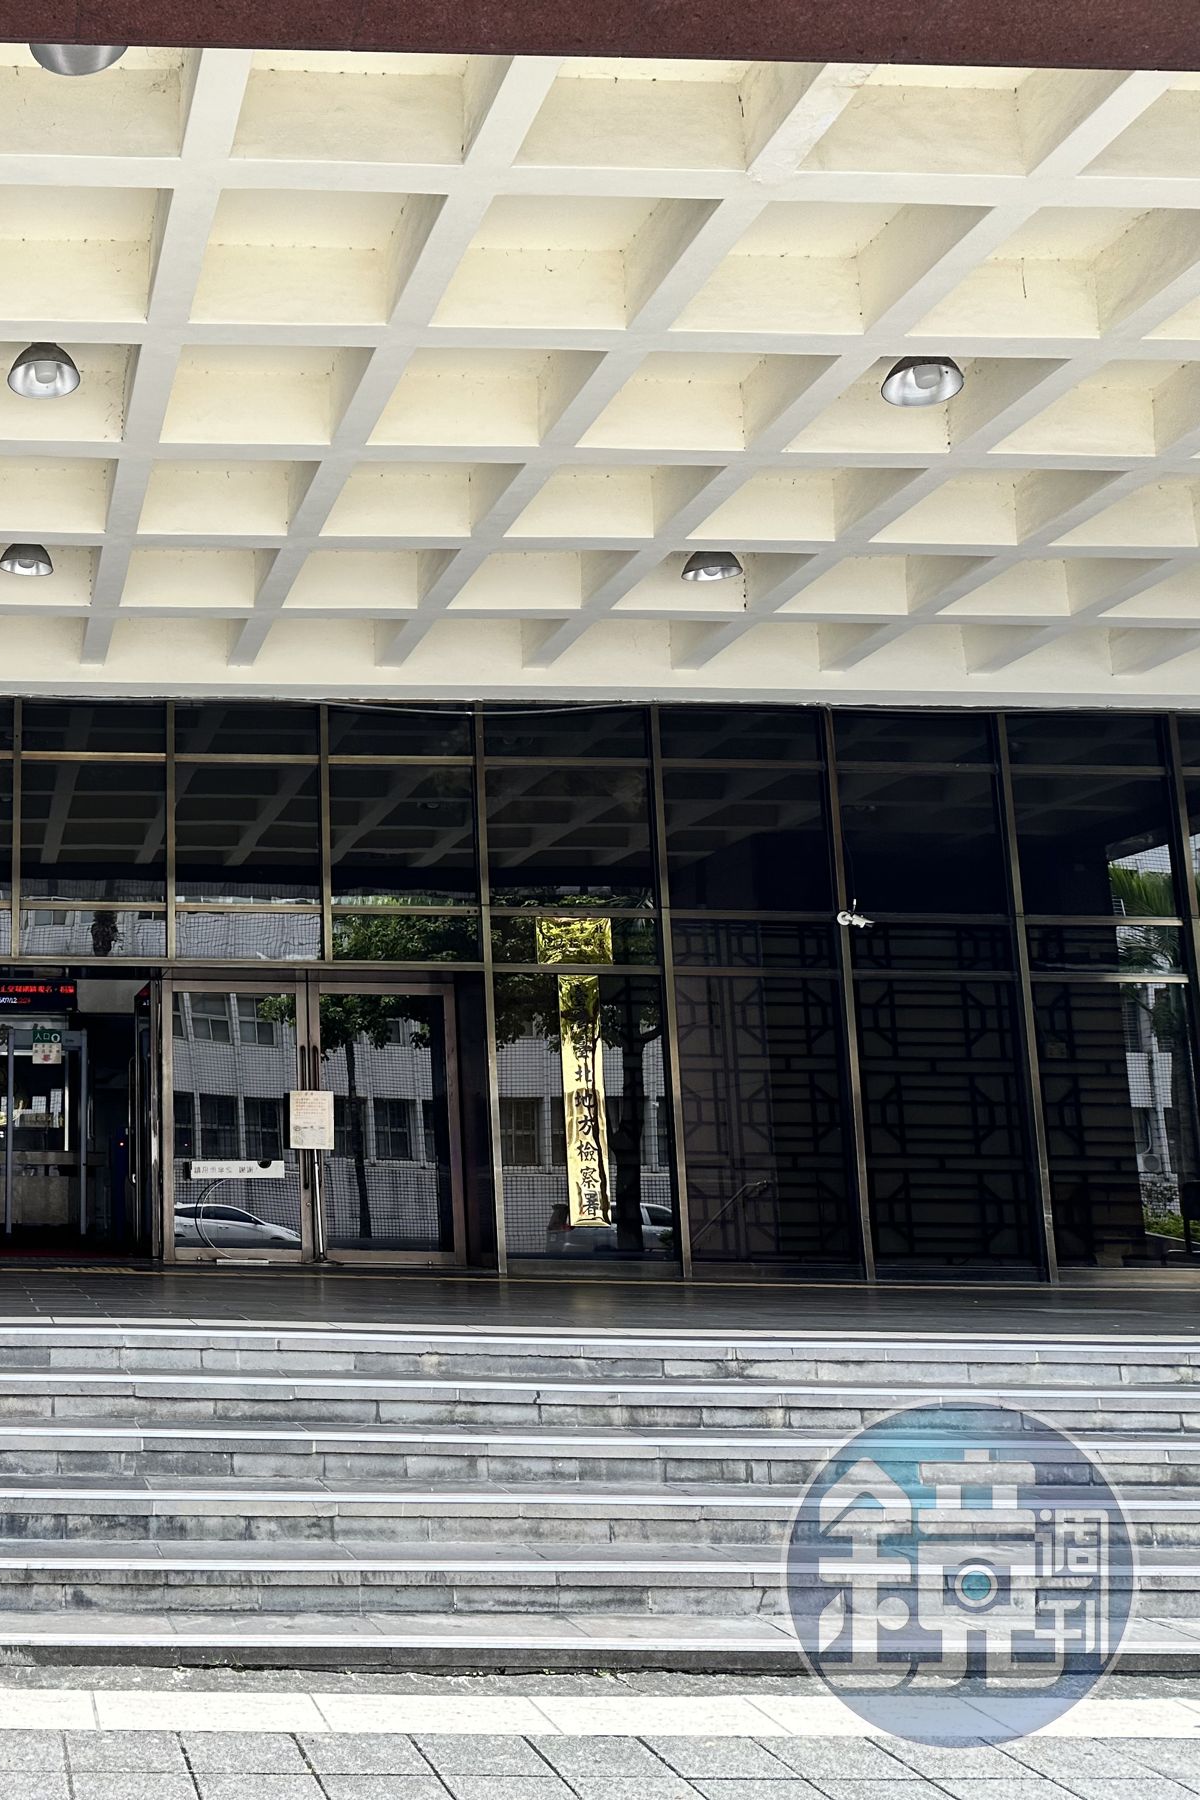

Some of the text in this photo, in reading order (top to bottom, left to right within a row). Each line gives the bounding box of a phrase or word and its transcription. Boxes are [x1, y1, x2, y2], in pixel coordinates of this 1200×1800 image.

[573, 985, 598, 1216] 臺臺北地方檢察署
